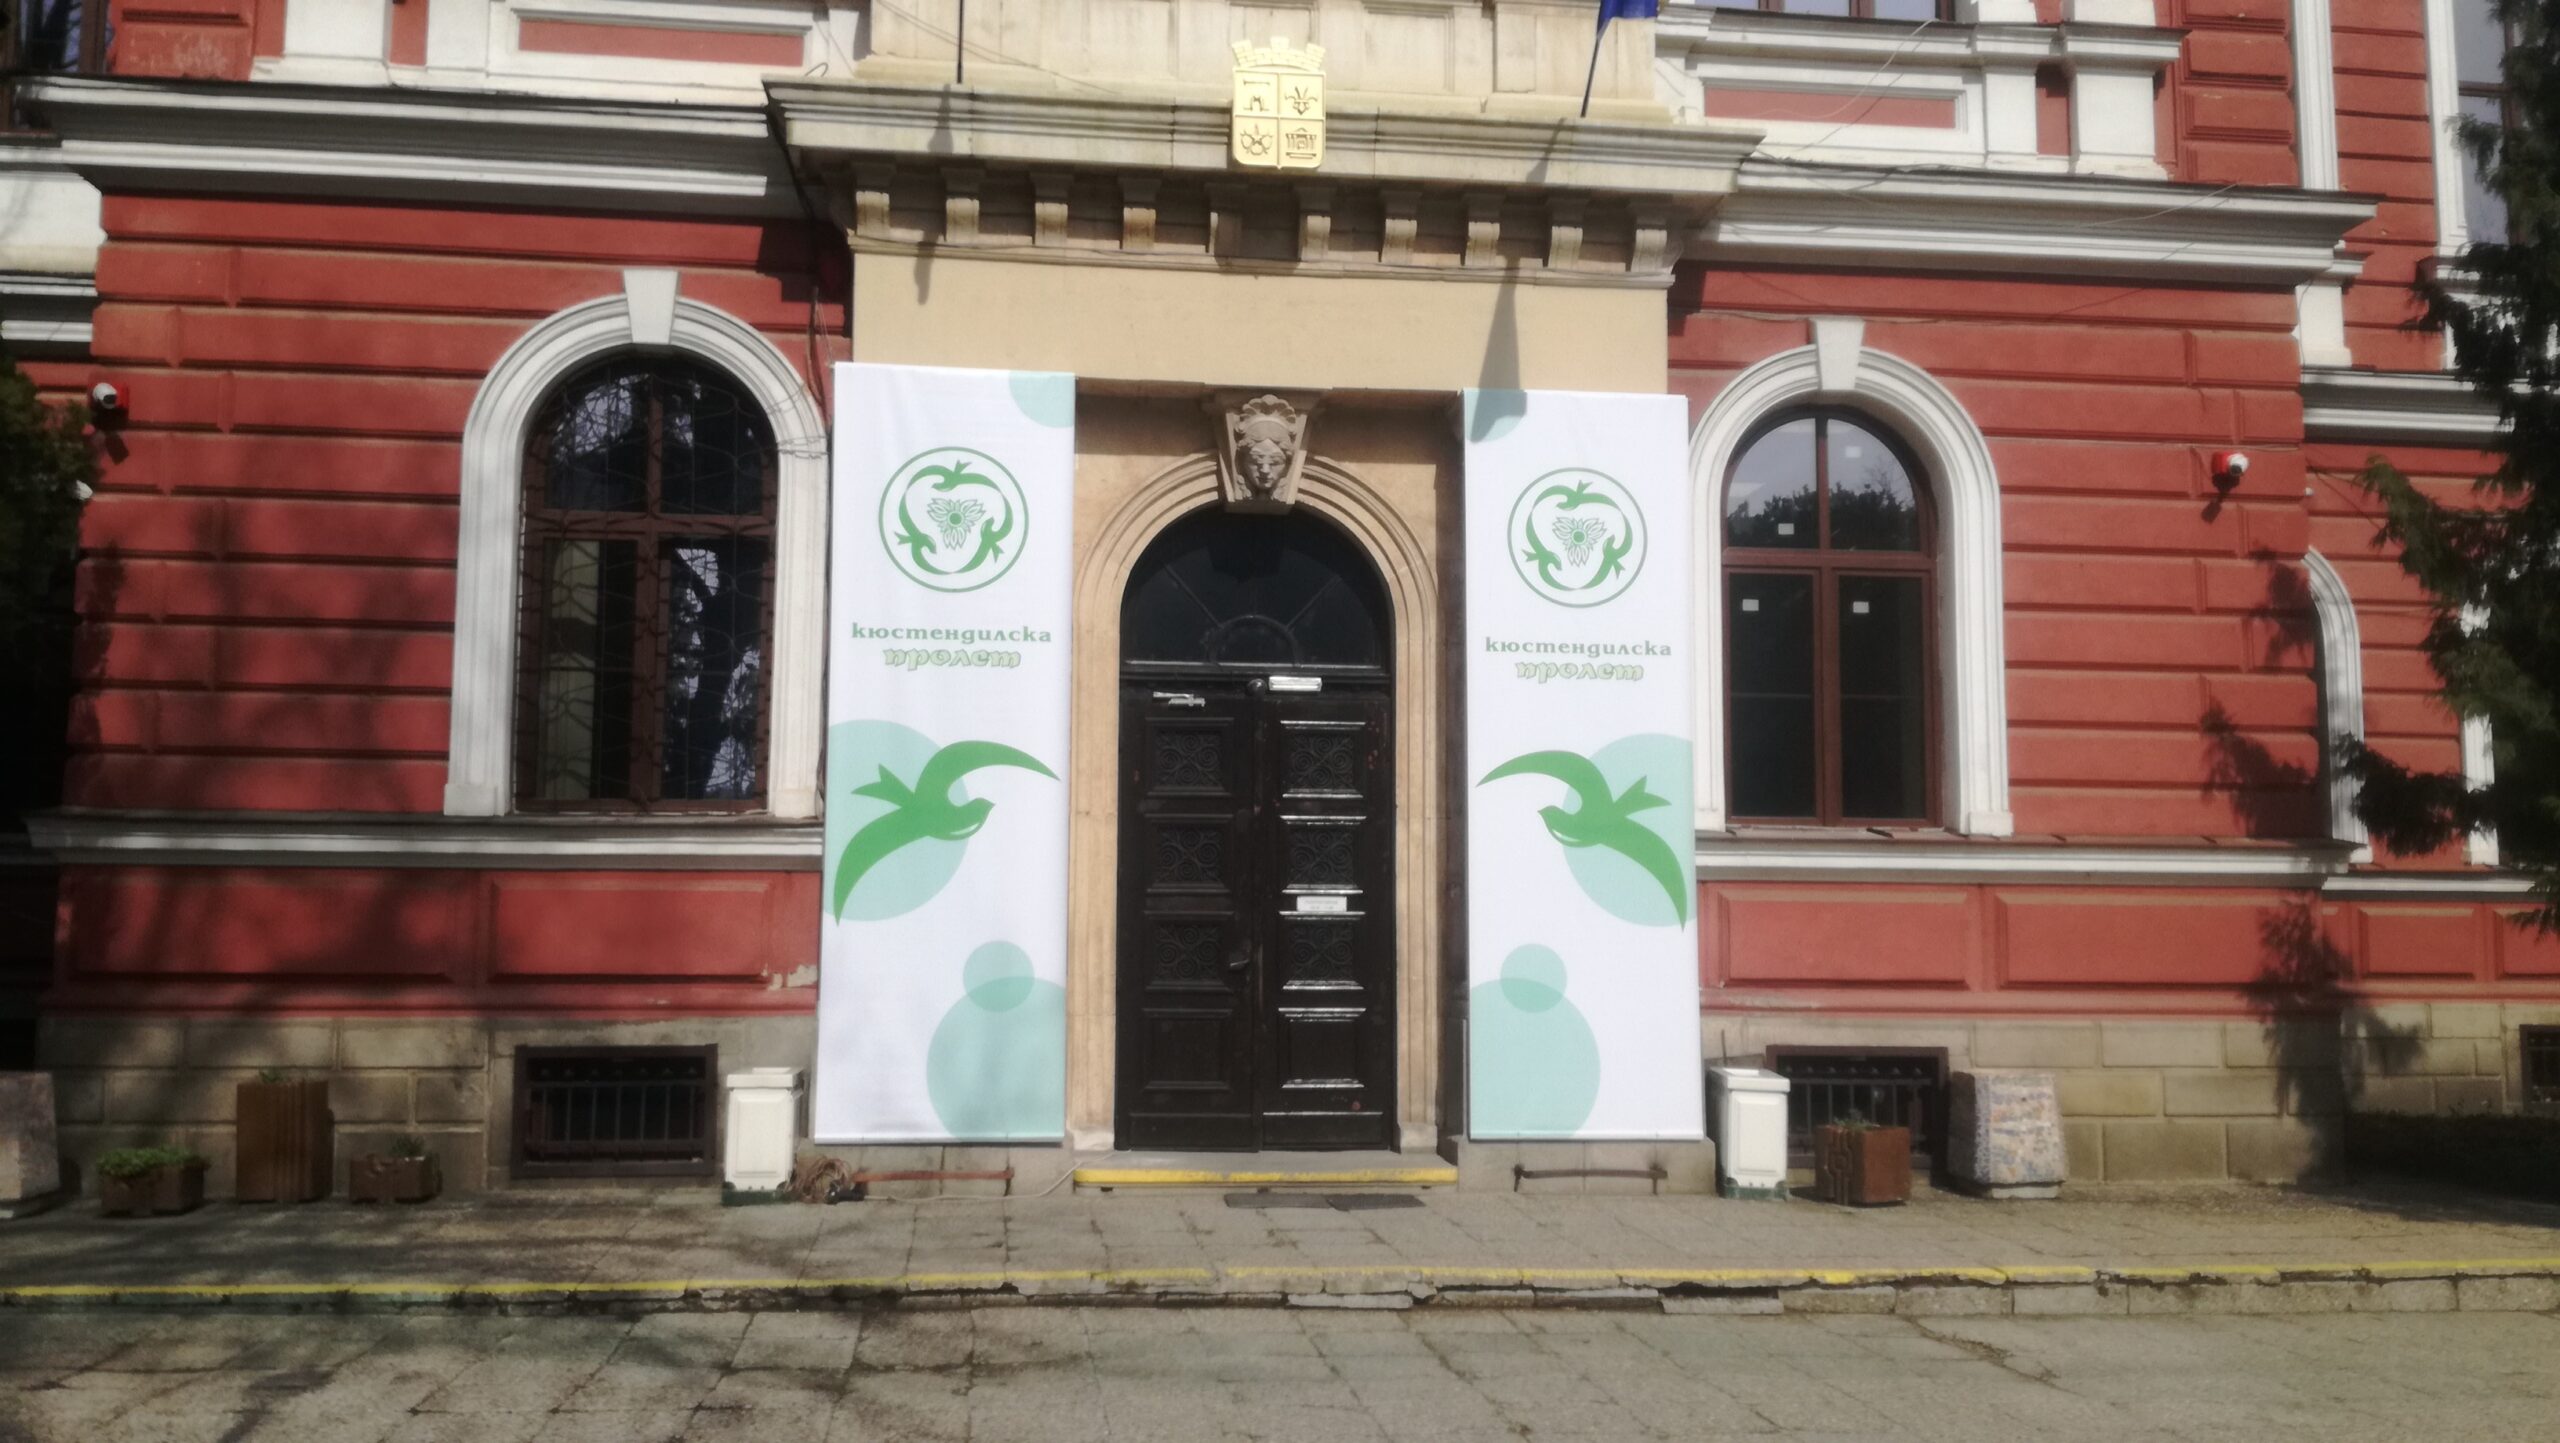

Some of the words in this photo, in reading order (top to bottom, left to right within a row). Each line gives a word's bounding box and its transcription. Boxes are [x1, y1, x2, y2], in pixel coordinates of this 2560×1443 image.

[851, 622, 1052, 645] кюстендилска
[882, 647, 1022, 671] пролет
[1485, 636, 1672, 659] кюстендилска
[1515, 661, 1644, 684] пролет
